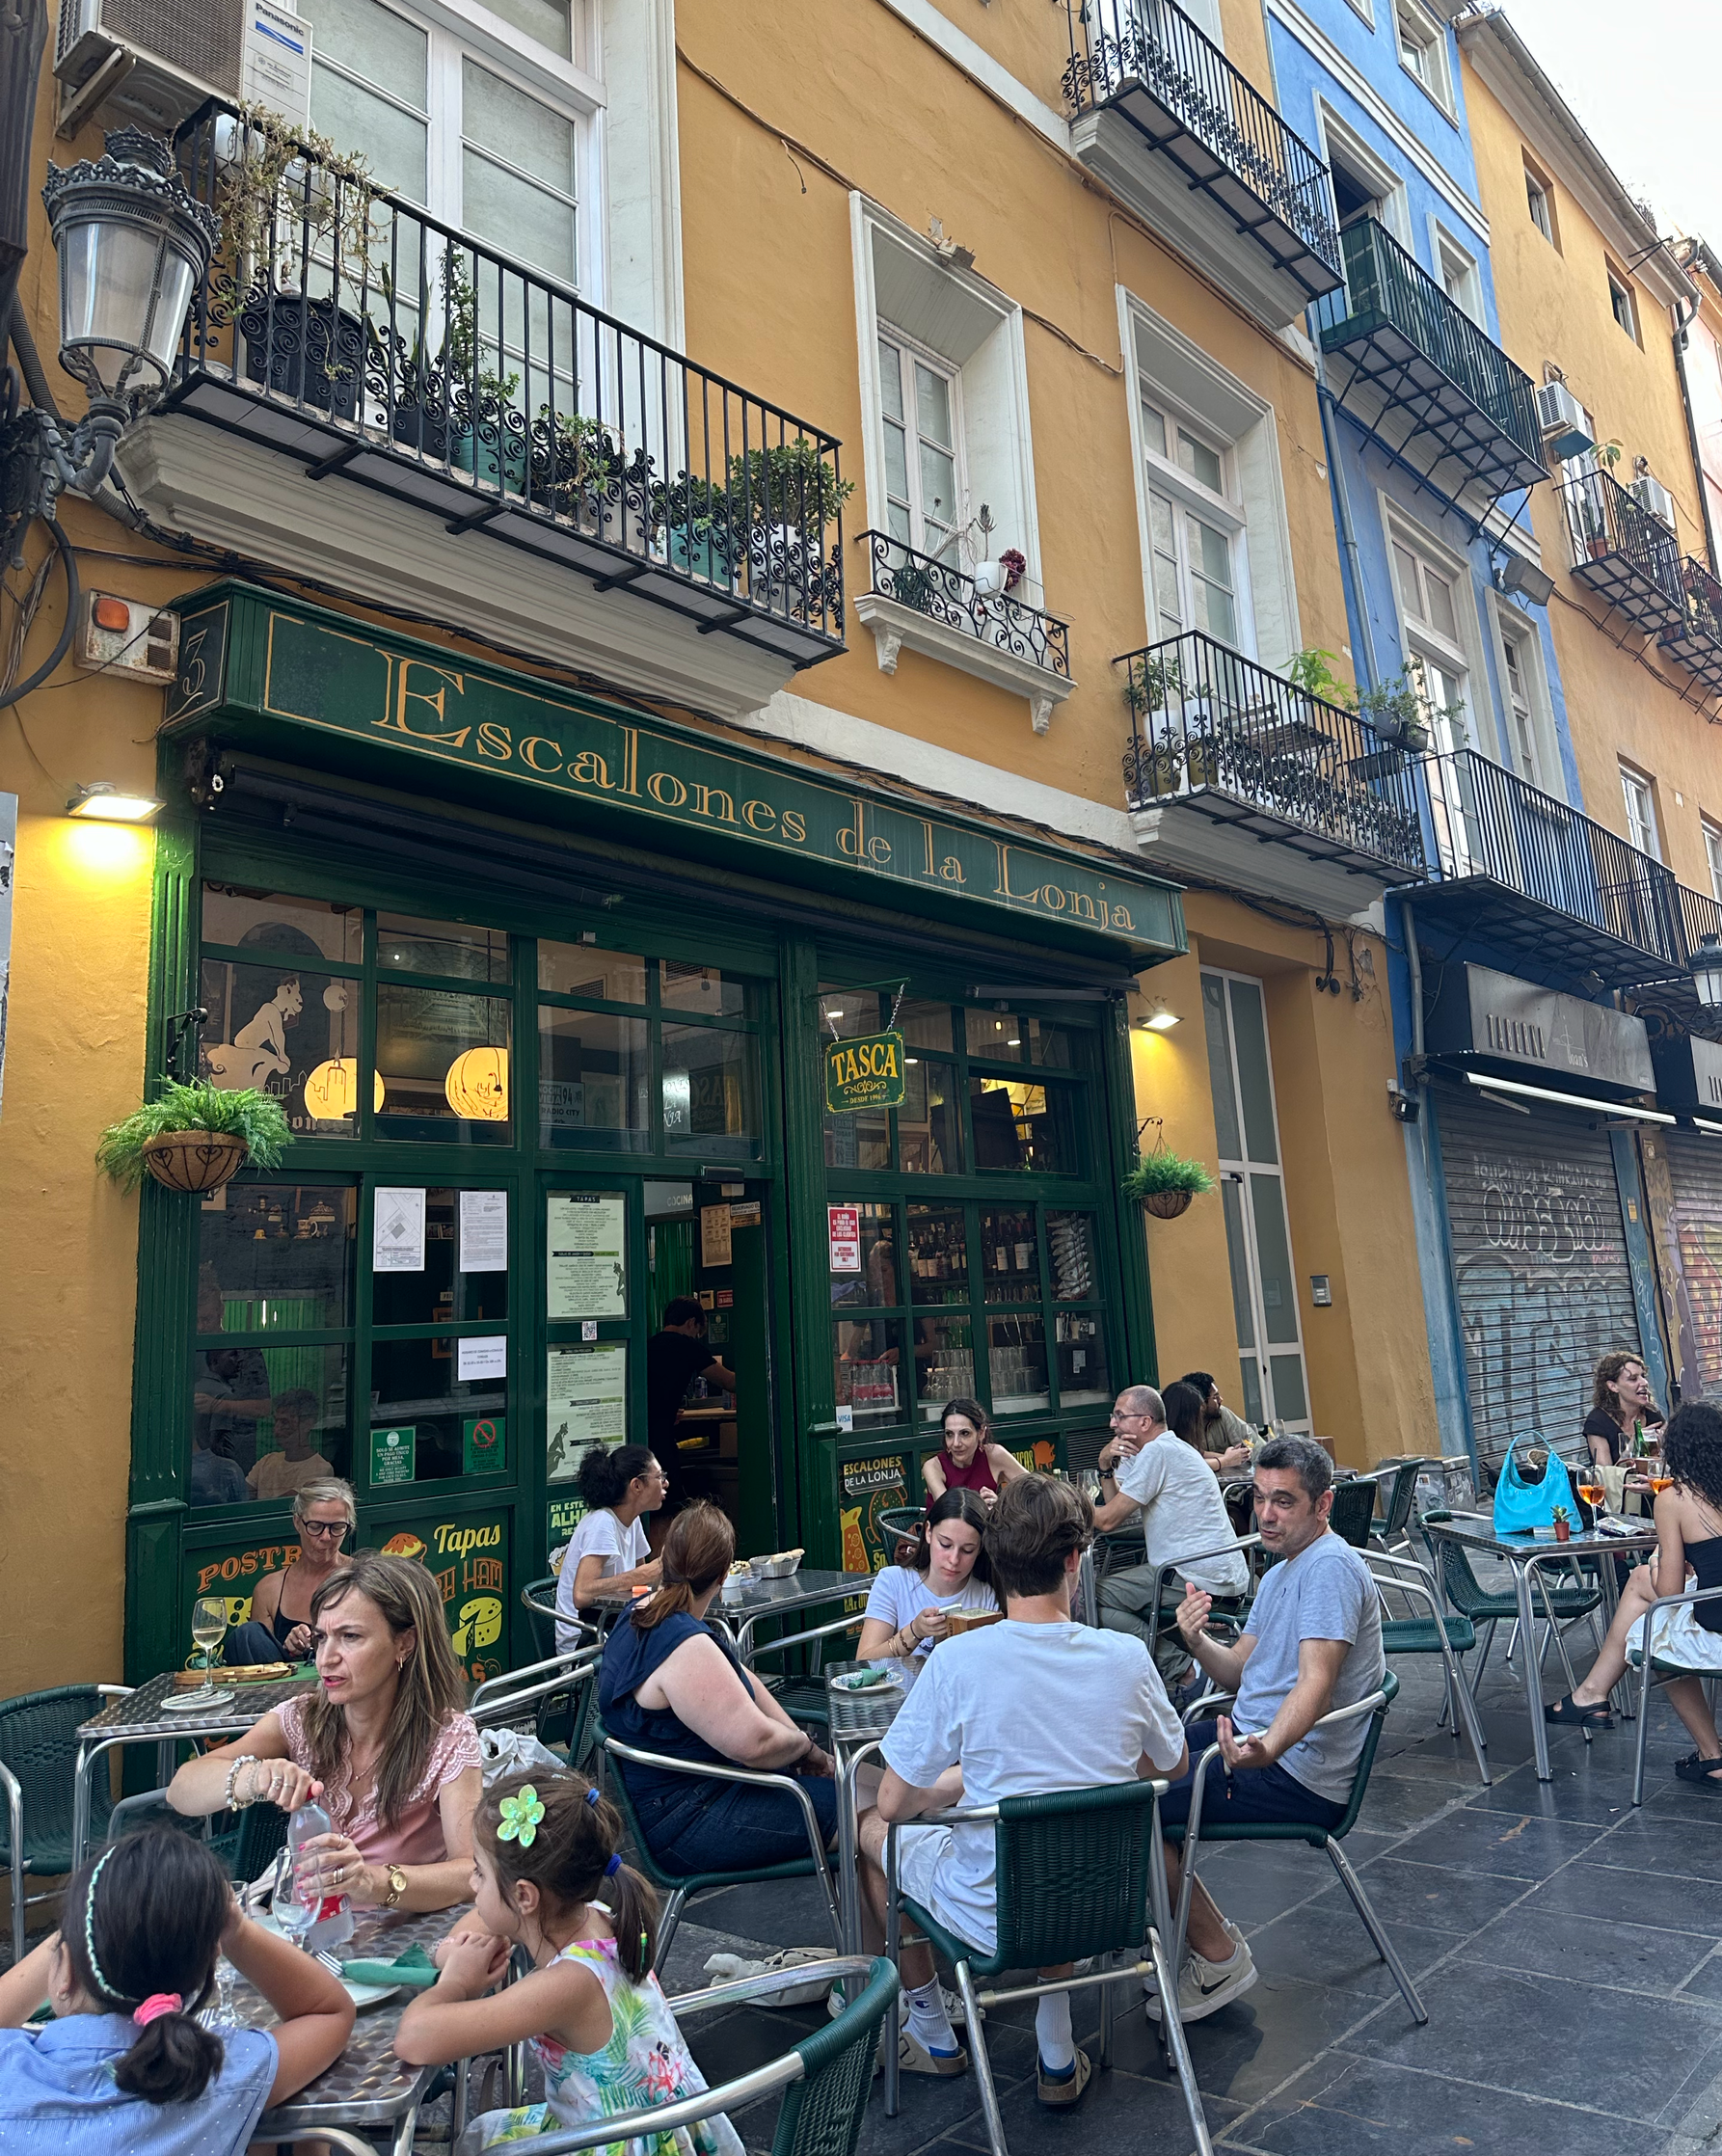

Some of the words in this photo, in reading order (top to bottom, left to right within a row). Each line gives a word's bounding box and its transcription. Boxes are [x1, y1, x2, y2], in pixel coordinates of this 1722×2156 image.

[256, 3, 305, 37] Panasonic
[371, 648, 806, 842] Escalones
[835, 800, 892, 863] de
[920, 822, 967, 883] la
[990, 841, 1137, 931] Lonja
[1487, 1013, 1546, 1059] TABERNA
[831, 1043, 899, 1087] TASCA
[541, 1107, 565, 1116] RADIO
[566, 1108, 580, 1117] CITY
[849, 1095, 868, 1104] DESDE
[666, 1194, 693, 1207] COCINA
[837, 1414, 851, 1423] VISA
[844, 1456, 902, 1476] ESCALONES
[845, 1477, 854, 1488] DE
[855, 1475, 866, 1485] LA
[868, 1469, 901, 1483] LONJA
[551, 1504, 562, 1513] EN
[564, 1500, 584, 1511] ESTE
[434, 1523, 500, 1559] Tapas
[197, 1545, 303, 1594] POSTR
[462, 1556, 503, 1594] HAM
